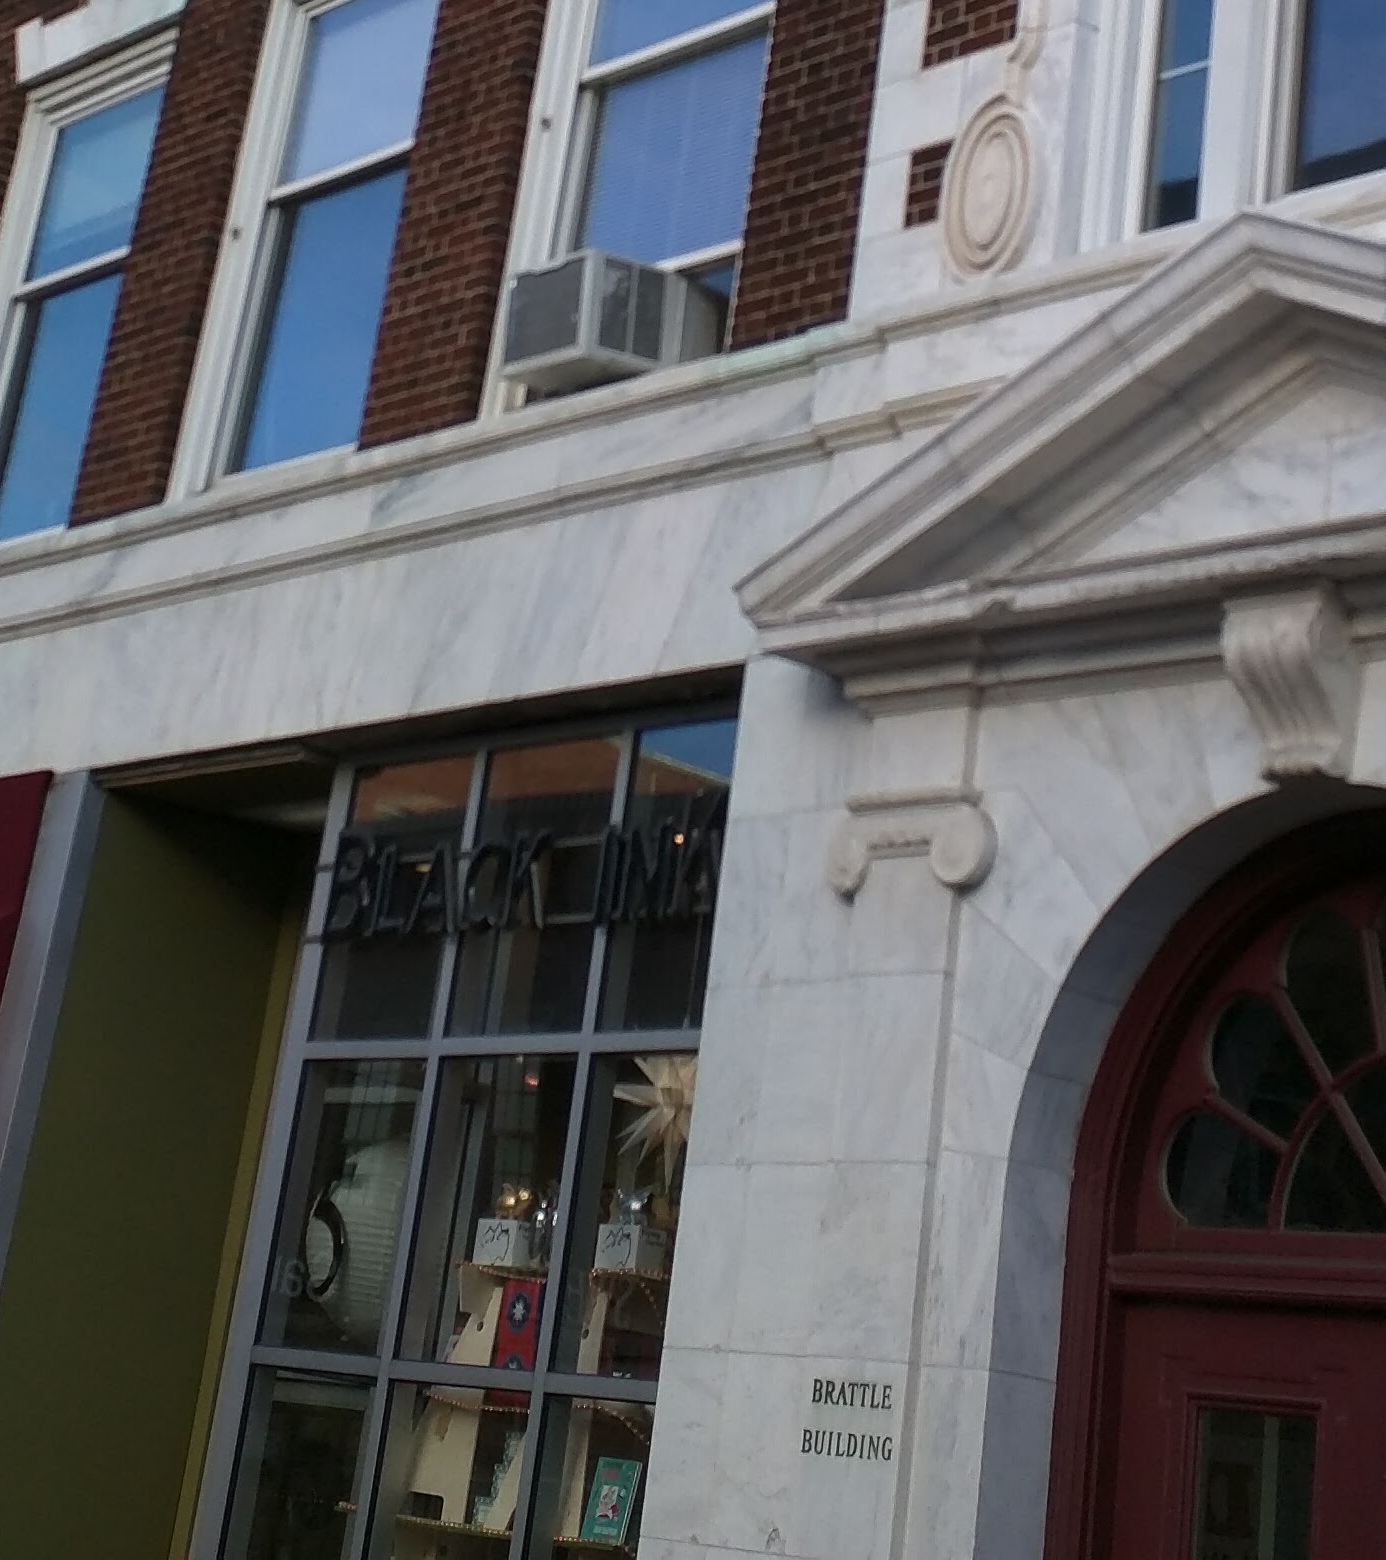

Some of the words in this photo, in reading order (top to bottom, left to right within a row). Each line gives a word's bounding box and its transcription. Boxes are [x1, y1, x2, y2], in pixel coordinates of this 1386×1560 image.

[323, 830, 550, 938] BLACK
[811, 1378, 893, 1410] BRATTLE
[800, 1428, 893, 1461] BUILDING
